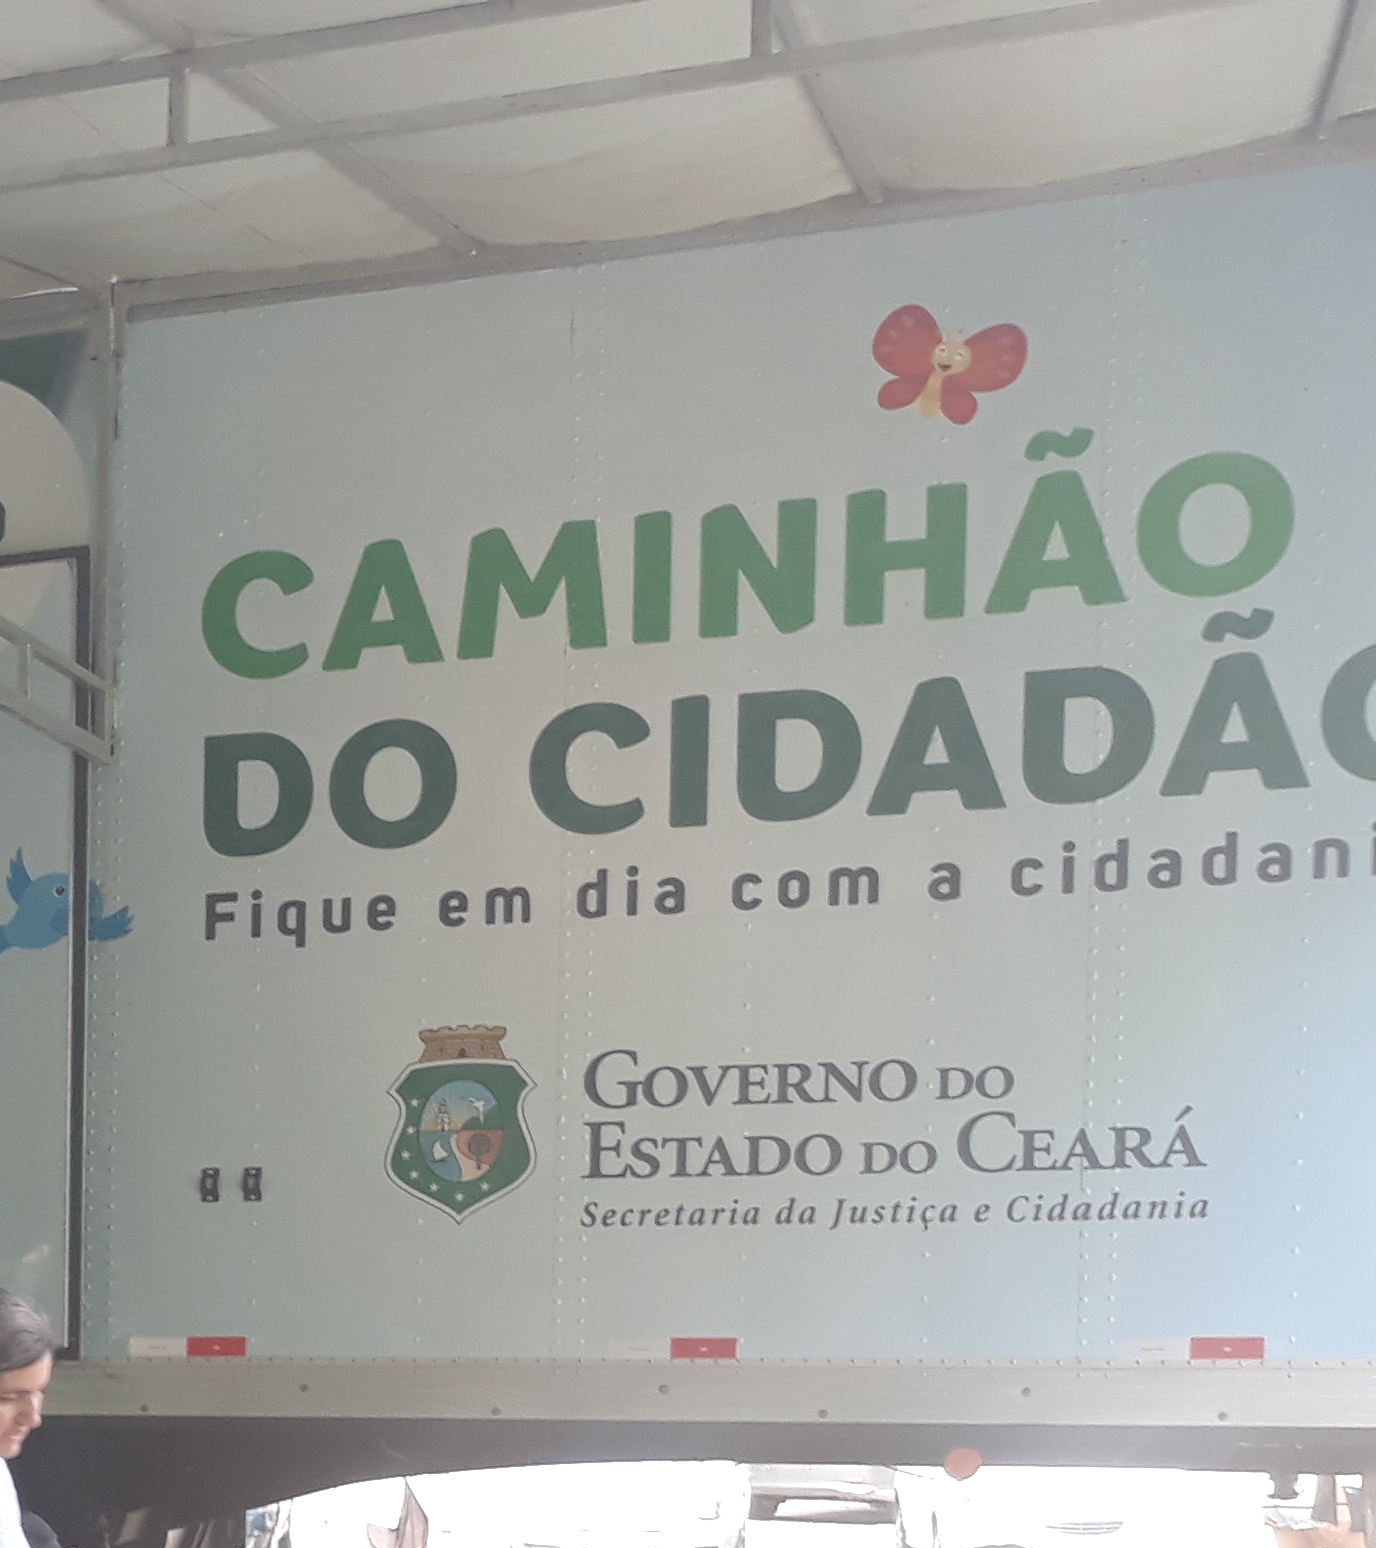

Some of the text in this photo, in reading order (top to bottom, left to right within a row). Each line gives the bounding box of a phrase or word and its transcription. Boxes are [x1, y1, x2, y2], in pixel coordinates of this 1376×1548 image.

[201, 427, 1295, 679] CAMINHÃO
[203, 718, 457, 857] DO
[204, 888, 398, 949] Fique
[438, 884, 532, 928] em
[576, 865, 687, 919] dia
[731, 864, 880, 911] com
[927, 861, 962, 901] a
[580, 1190, 1210, 1232] Secretaria da Justiça e Cidadania
